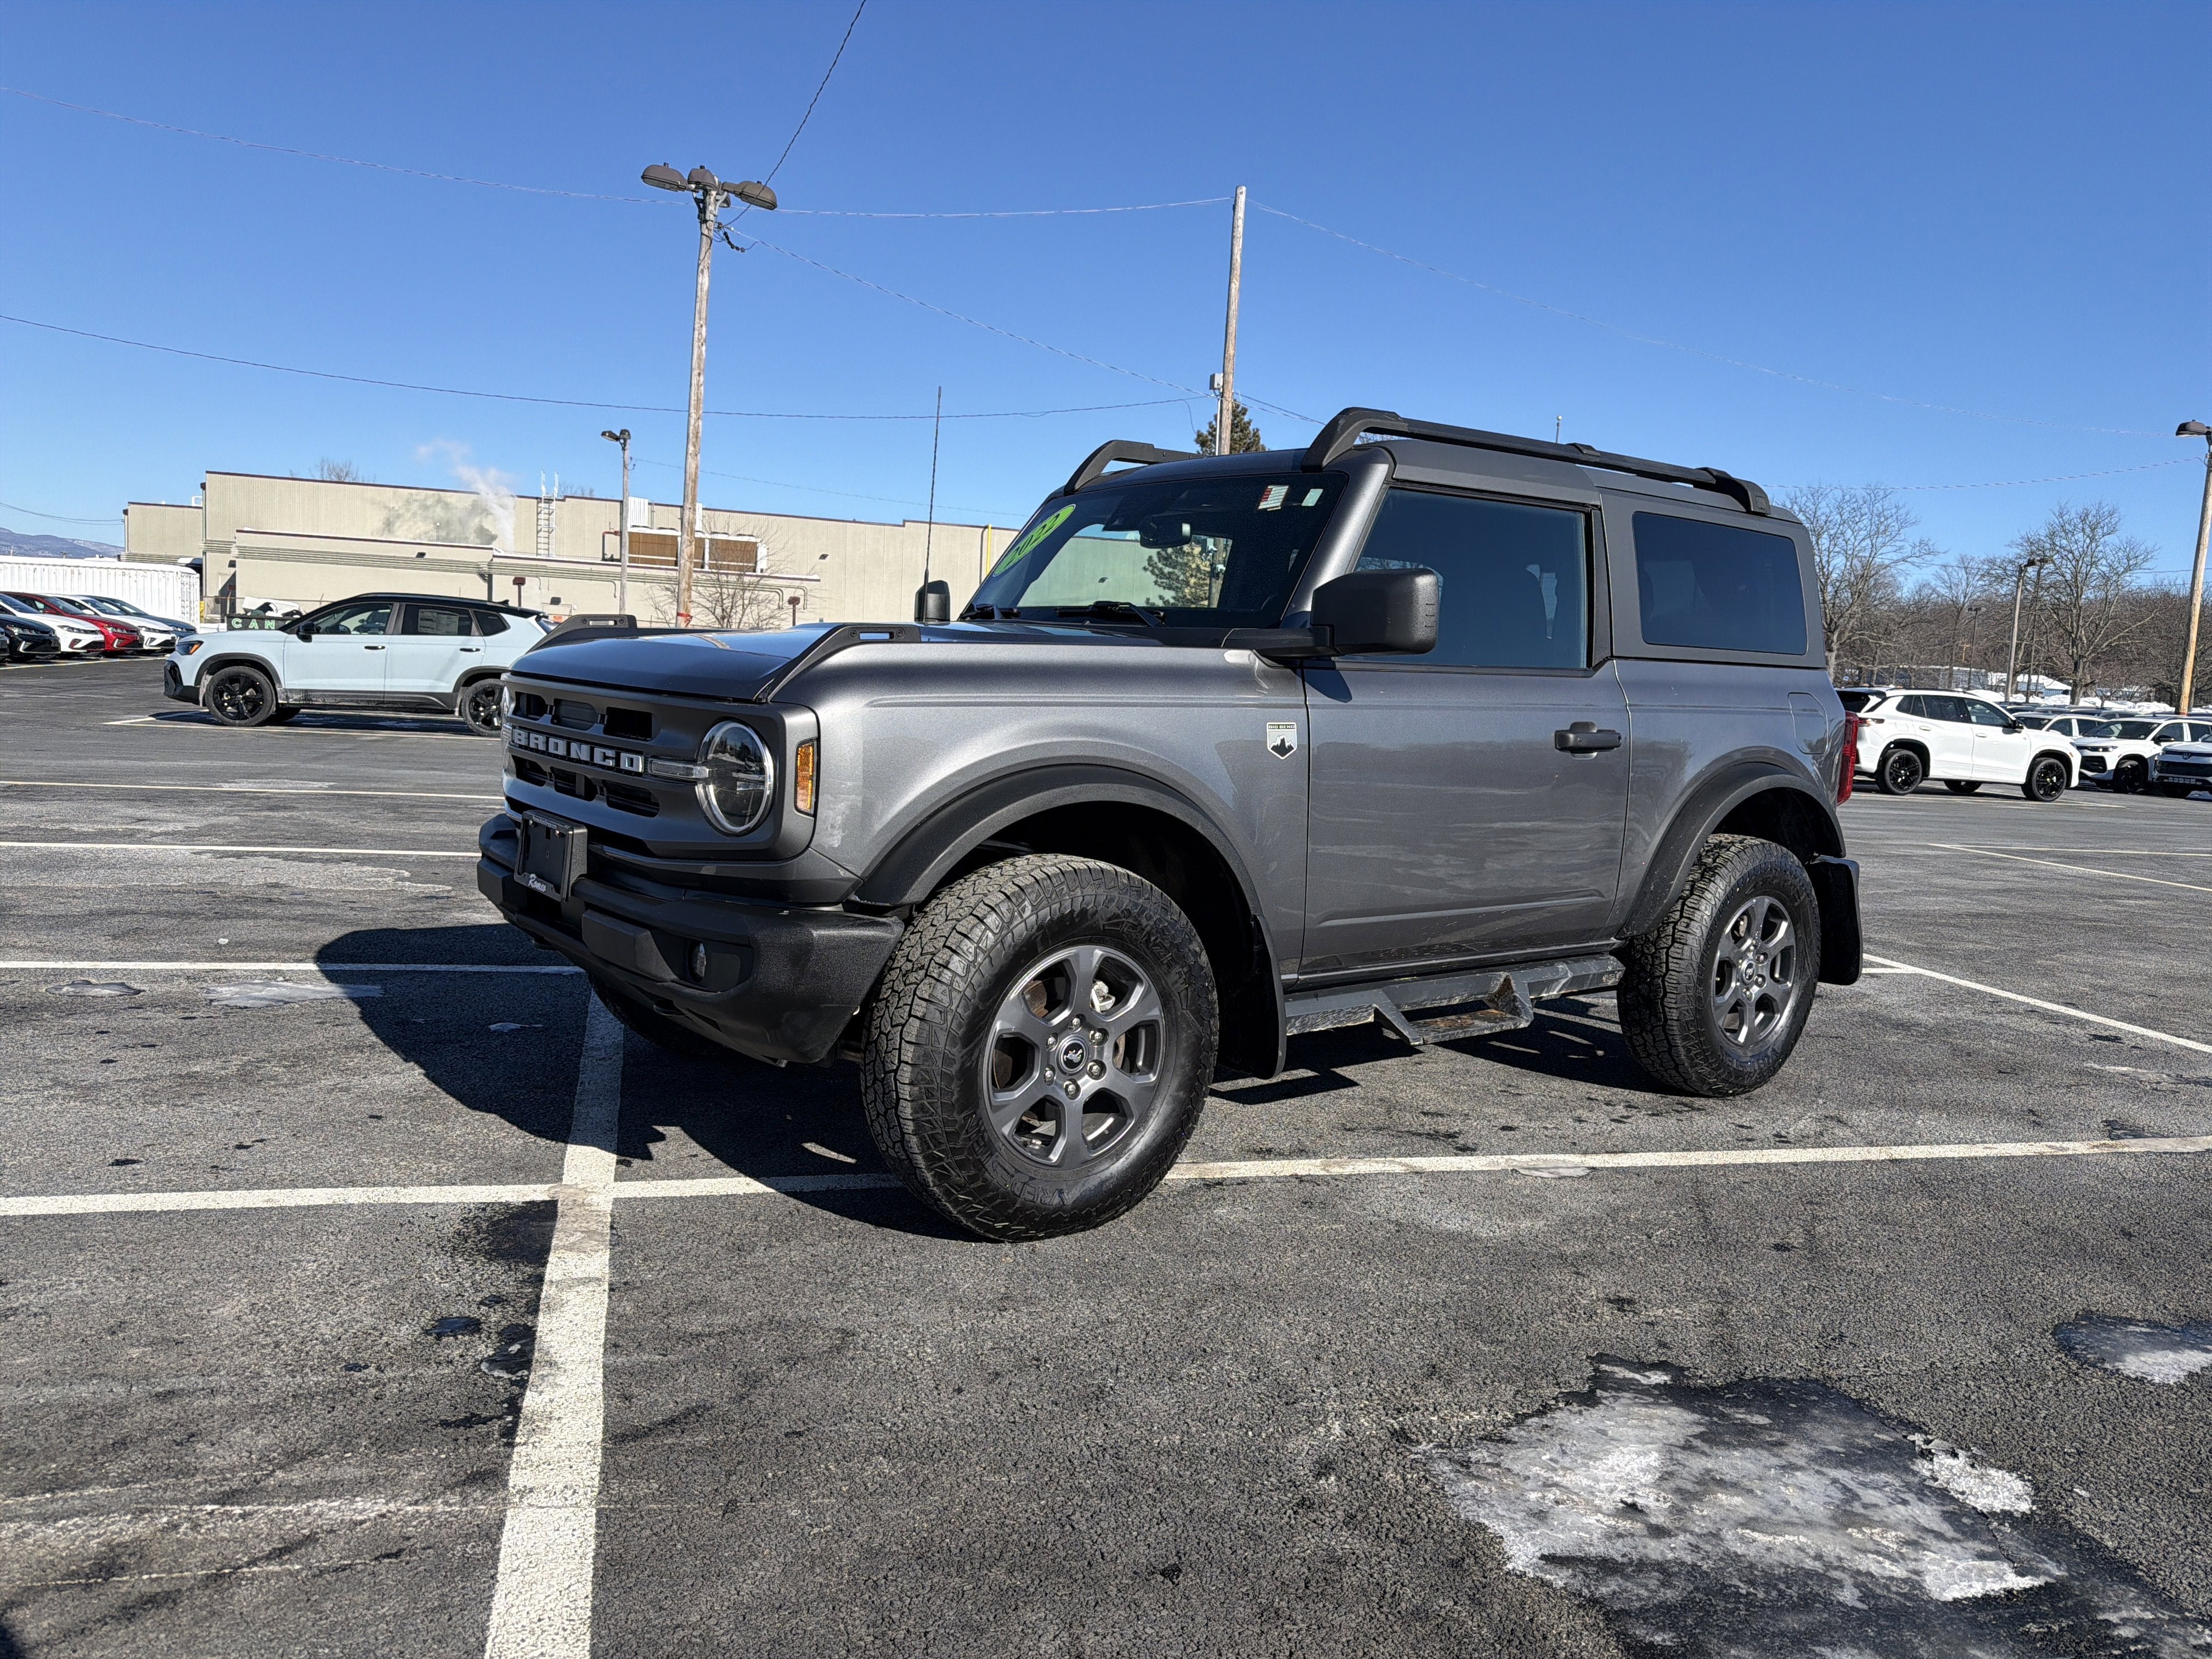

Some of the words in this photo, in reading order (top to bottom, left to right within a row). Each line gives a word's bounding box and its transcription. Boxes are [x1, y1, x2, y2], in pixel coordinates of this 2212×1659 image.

[1004, 513, 1060, 568] 2022
[232, 618, 292, 629] CAN
[514, 729, 644, 772] BRONCO
[962, 1110, 1070, 1206] VREDESTEIN
